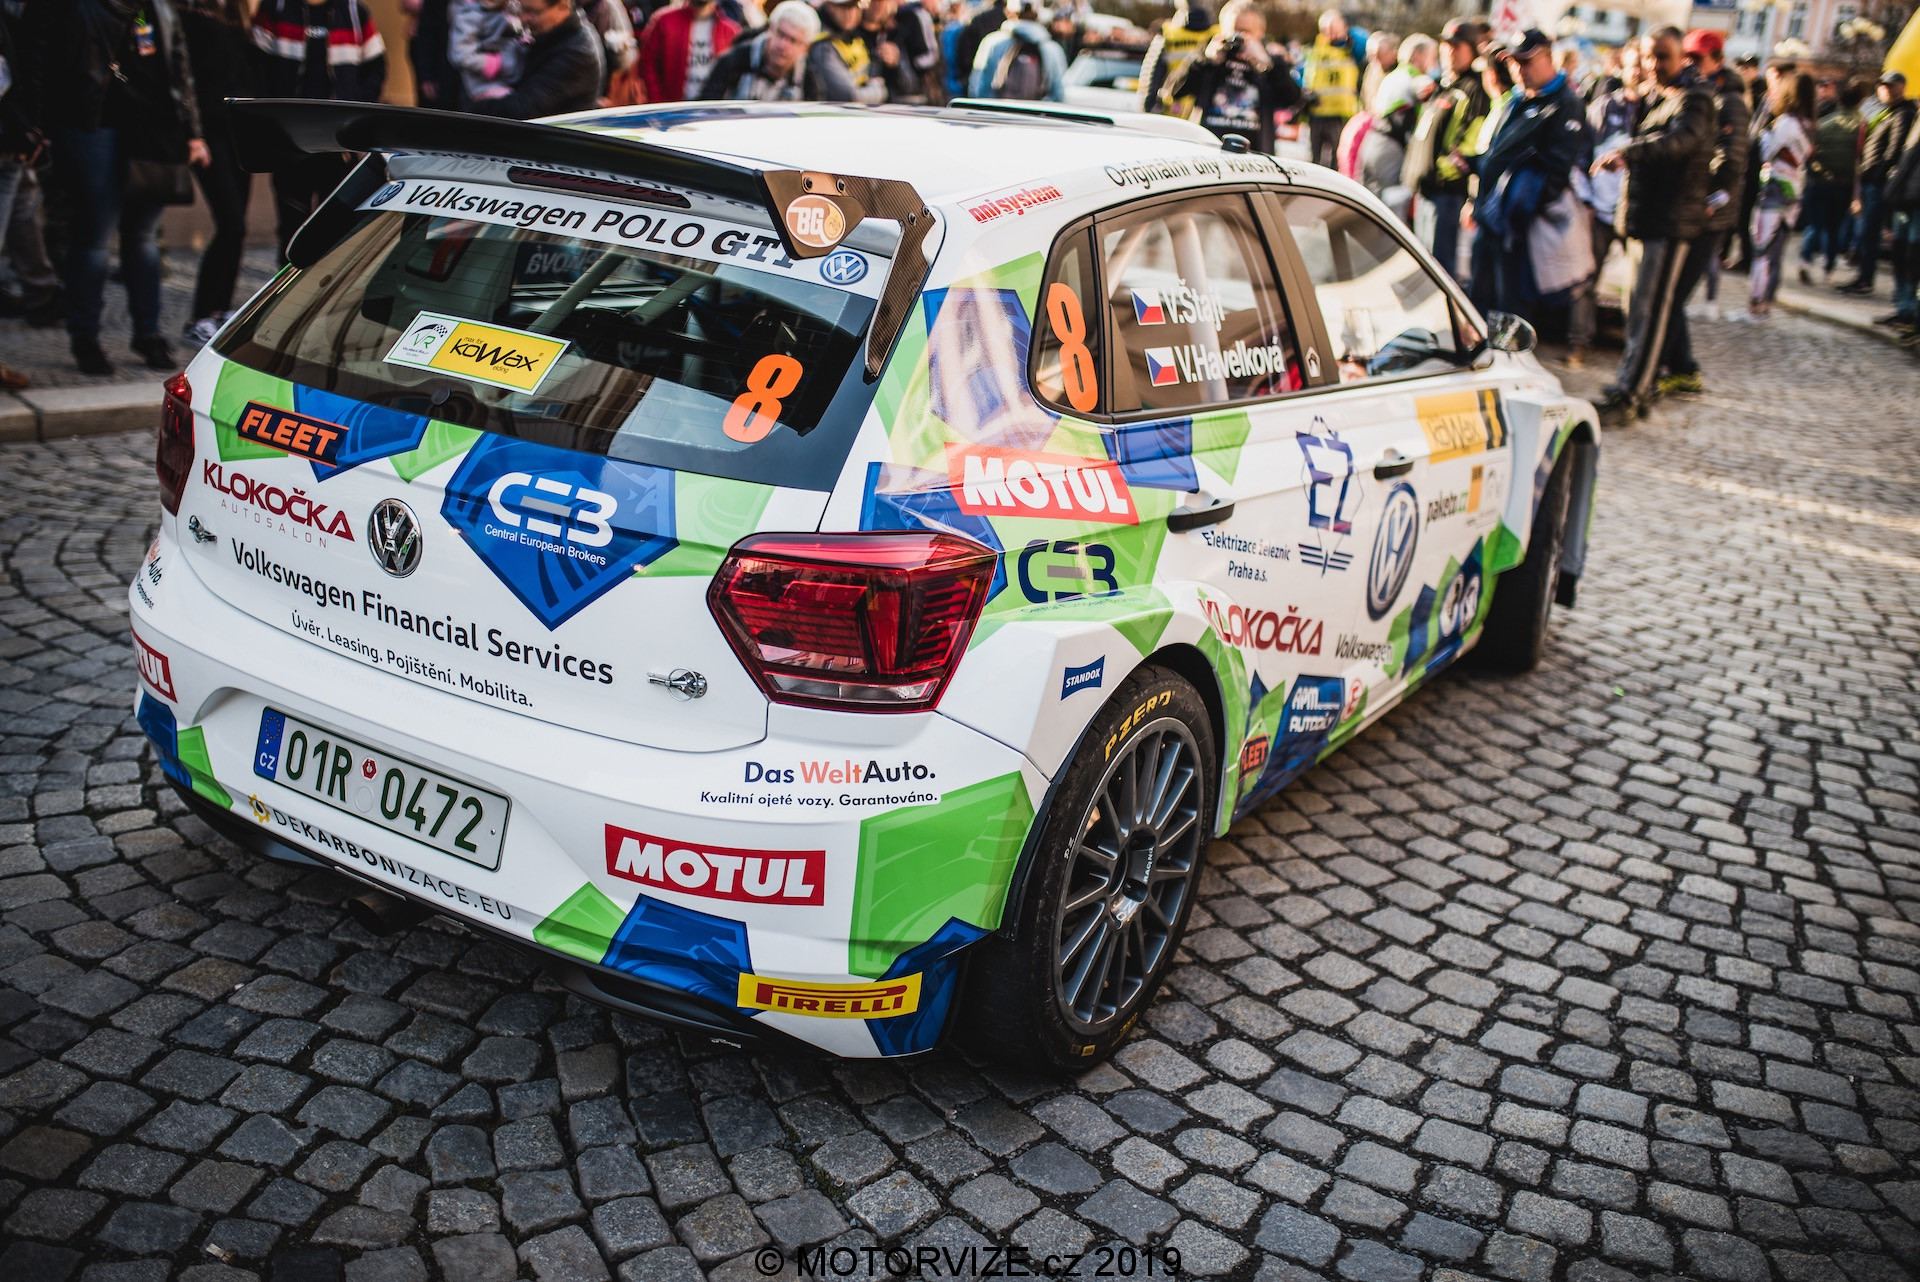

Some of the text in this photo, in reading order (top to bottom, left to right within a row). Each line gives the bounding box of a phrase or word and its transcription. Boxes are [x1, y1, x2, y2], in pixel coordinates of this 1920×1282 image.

[405, 185, 587, 228] Volkswagen
[592, 209, 705, 248] POLO
[1046, 282, 1098, 413] 8
[1174, 337, 1286, 384] V.Havelková
[723, 354, 804, 444] 8
[241, 408, 339, 457] FLEET
[203, 458, 356, 542] KLOKOČKA
[963, 455, 1129, 515] MOTUL
[221, 499, 327, 549] AUTOSALON
[484, 524, 606, 566] Central European Brokers
[1228, 560, 1253, 580] Praha
[231, 537, 613, 685] Volkswagen Financial Services
[1198, 598, 1324, 656] KLOKOČKA
[135, 639, 171, 693] TUL
[292, 609, 533, 707] Úvěr. Leasing. Pojištění. Mobilita.
[1335, 633, 1393, 668] Volkswagen
[1065, 668, 1101, 688] STANDOX
[260, 752, 276, 772] CZ
[744, 759, 936, 784] Das WeltAuto.
[285, 730, 484, 853] 01R 0472
[700, 791, 938, 809] Kvalitní ojeté vozy. Garantováno.
[272, 809, 512, 920] DEKARBONIZACE.EU
[614, 836, 815, 898] MOTUL
[755, 982, 908, 1014] PIRELLI
